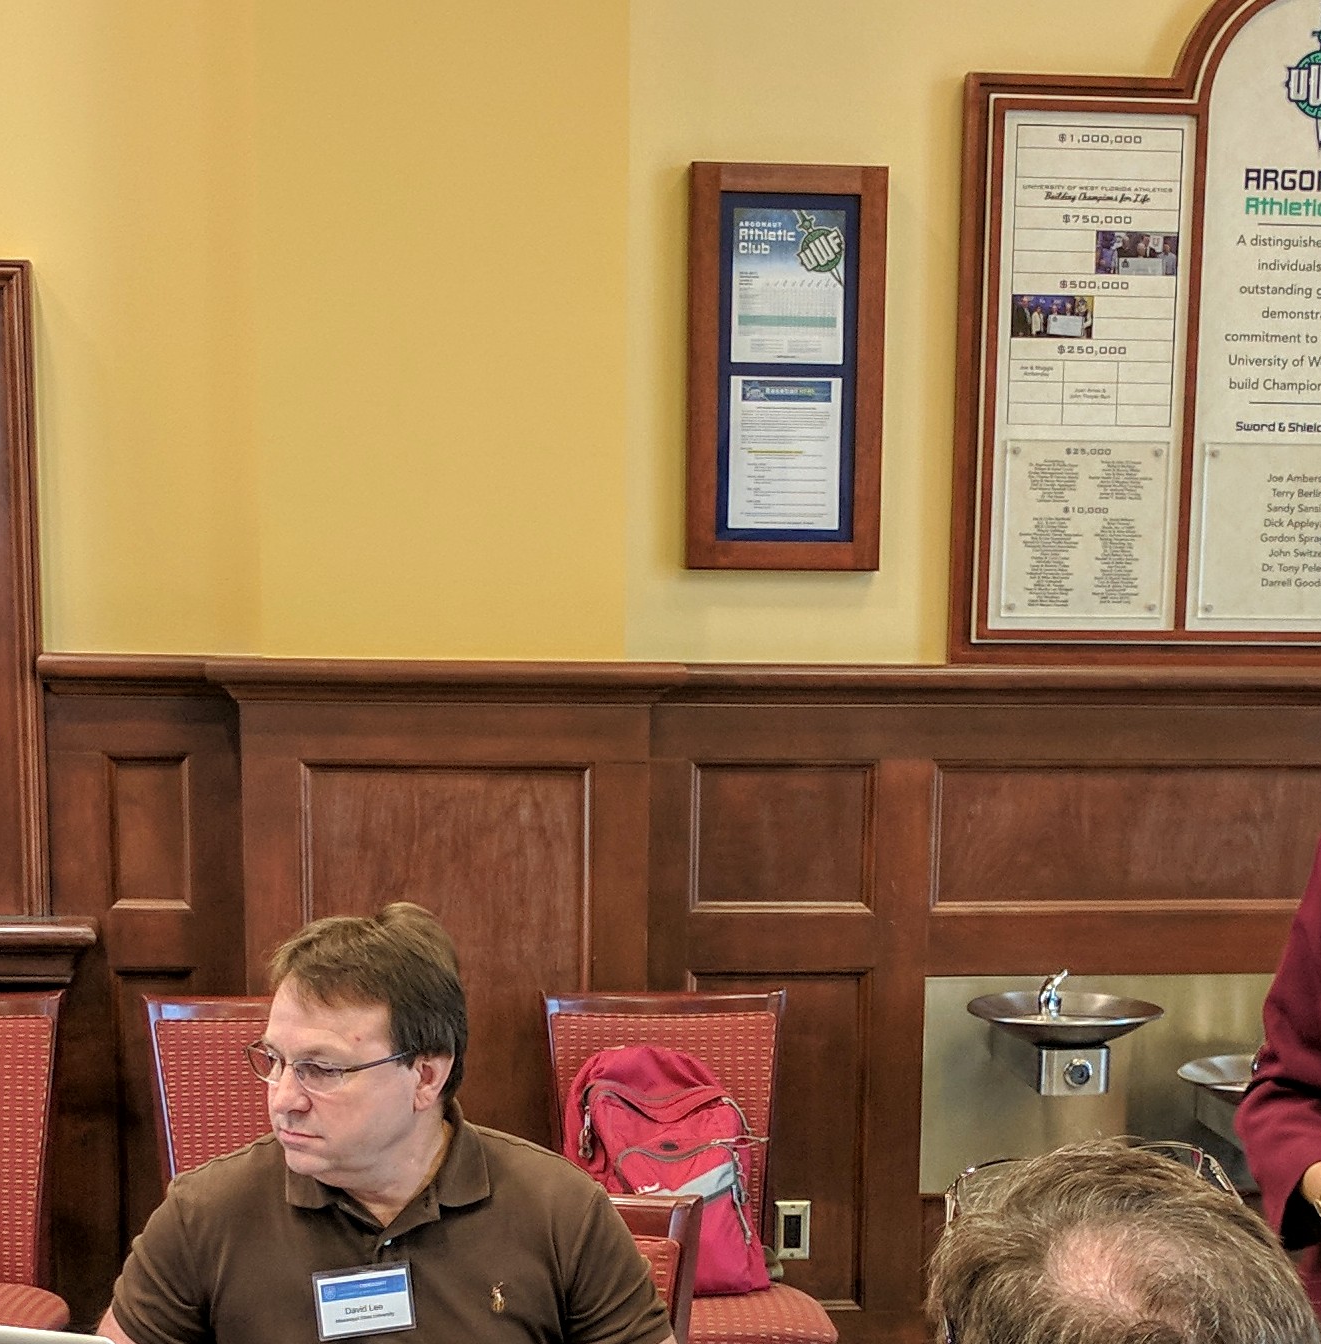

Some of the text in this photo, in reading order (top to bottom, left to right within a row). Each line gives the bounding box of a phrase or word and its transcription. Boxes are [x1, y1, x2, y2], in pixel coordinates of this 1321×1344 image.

[1058, 133, 1142, 144] $1,000,000
[1044, 191, 1076, 202] Building
[1078, 191, 1118, 202] Champions
[1119, 193, 1132, 203] for
[1063, 214, 1132, 225] $750,000
[739, 228, 796, 241] Athletic
[1236, 234, 1246, 246] A
[739, 242, 771, 254] Club
[798, 230, 842, 271] UWF
[1257, 259, 1321, 272] individuals
[1059, 280, 1129, 290] $500,000
[1239, 284, 1313, 299] outstanding
[1224, 331, 1301, 343] commitment
[1305, 333, 1318, 343] to
[1057, 345, 1127, 356] $250,000
[1228, 354, 1288, 370] University
[1291, 355, 1305, 367] of
[1229, 377, 1260, 391] build
[1235, 421, 1276, 432] Sword
[1278, 422, 1286, 432] &
[1267, 473, 1284, 483] Joe
[1272, 488, 1296, 499] Terry
[1267, 503, 1295, 514] Sandy
[1263, 518, 1284, 528] Dick
[1260, 533, 1296, 543] Gordon
[1268, 549, 1291, 558] John
[1262, 563, 1274, 572] Dr.
[1278, 563, 1300, 575] Tony
[1261, 578, 1292, 587] Darrell
[345, 1304, 367, 1315] David
